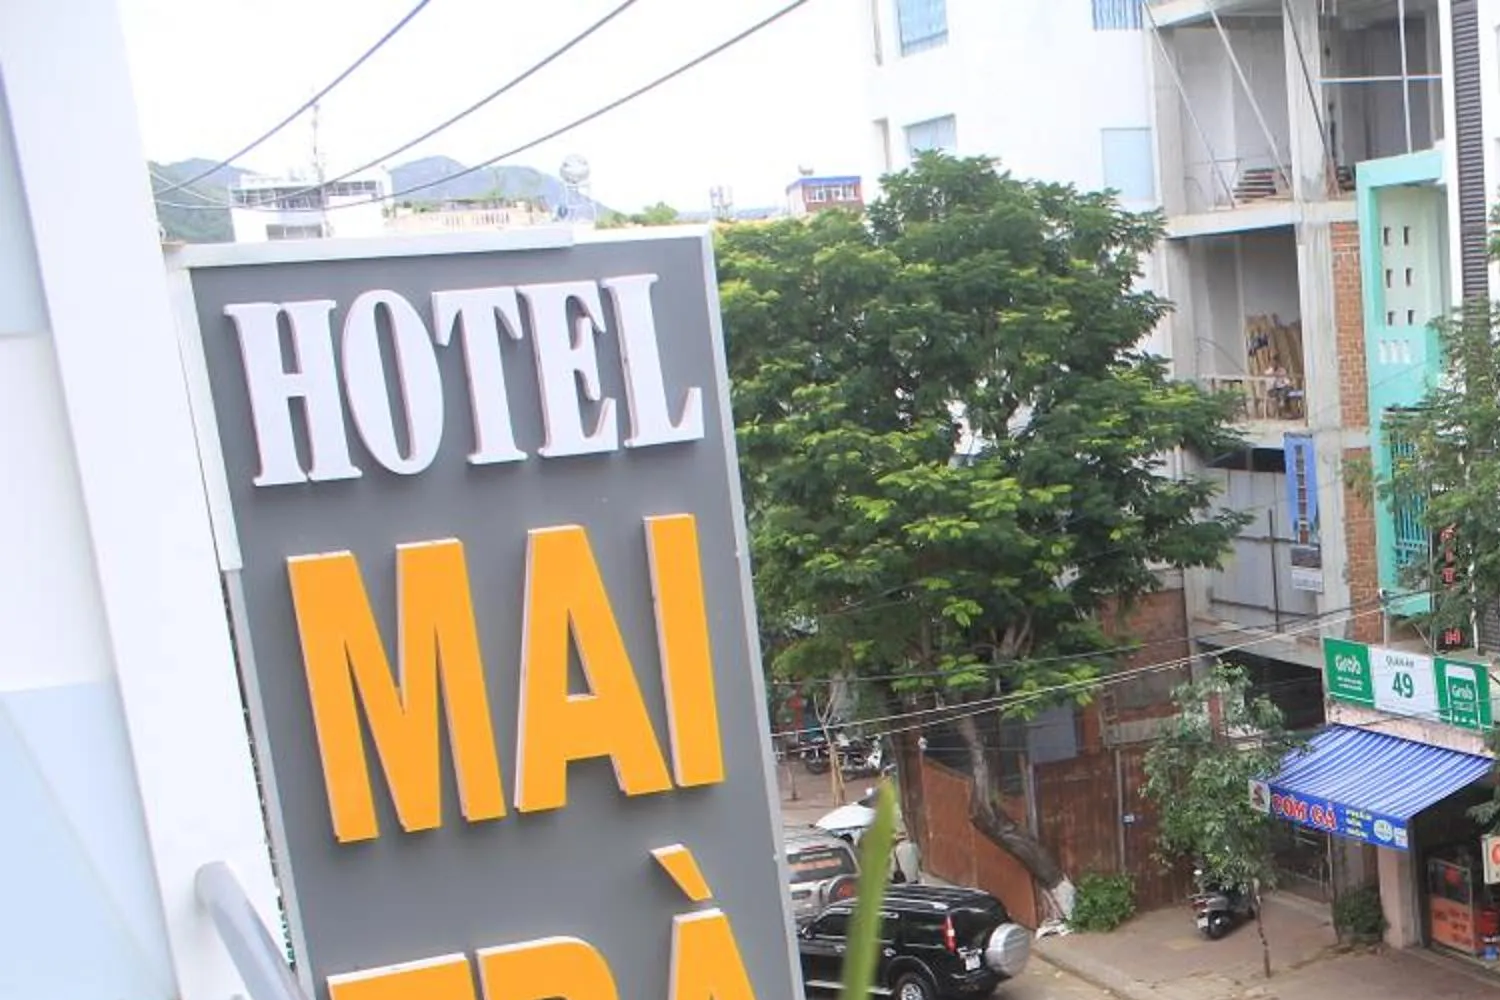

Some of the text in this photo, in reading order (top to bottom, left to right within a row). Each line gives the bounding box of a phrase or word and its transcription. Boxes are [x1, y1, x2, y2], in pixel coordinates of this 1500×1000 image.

[224, 274, 703, 486] HOTEL
[287, 514, 725, 843] MAI
[1392, 671, 1414, 699] 49
